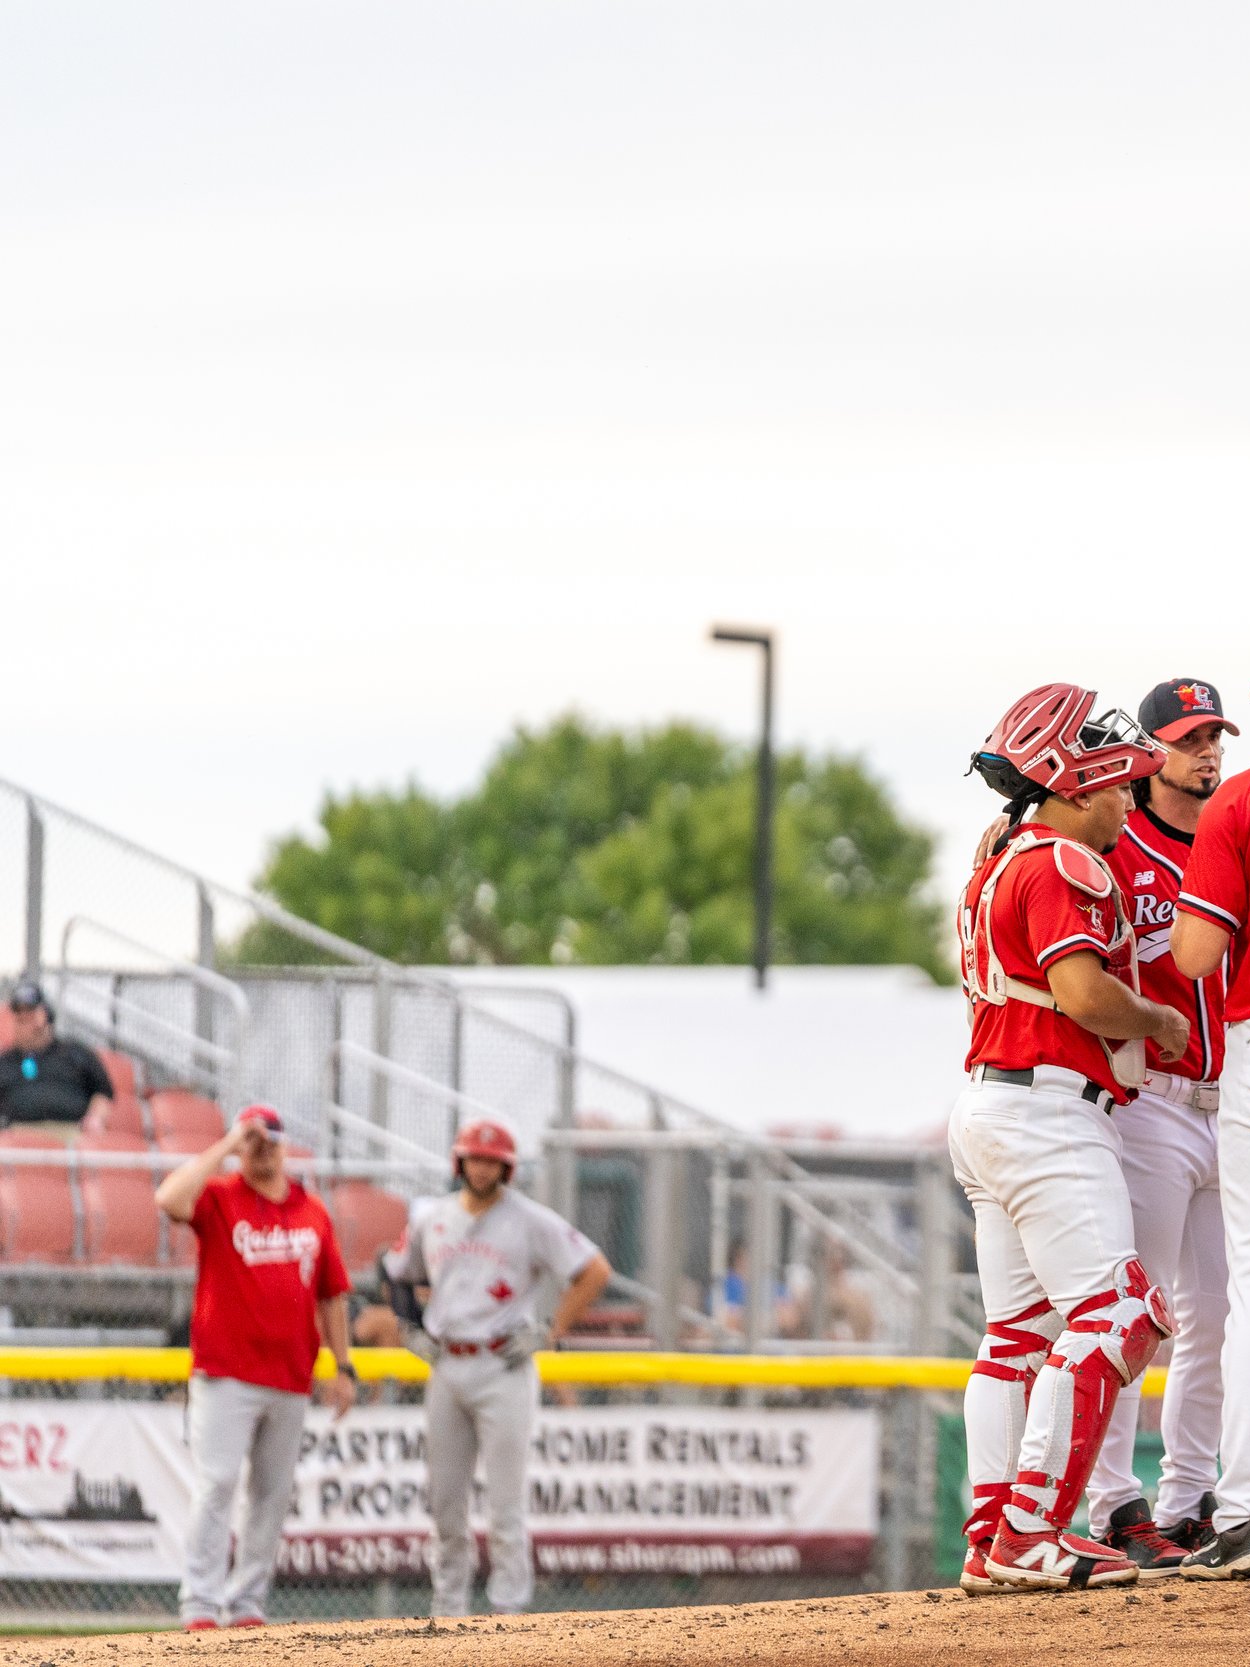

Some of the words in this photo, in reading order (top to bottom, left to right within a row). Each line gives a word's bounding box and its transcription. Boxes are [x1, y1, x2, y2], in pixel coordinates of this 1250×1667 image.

[300, 1429, 425, 1462] PARTM
[645, 1422, 812, 1467] RENTALS
[530, 1479, 798, 1519] MANAGEMENT
